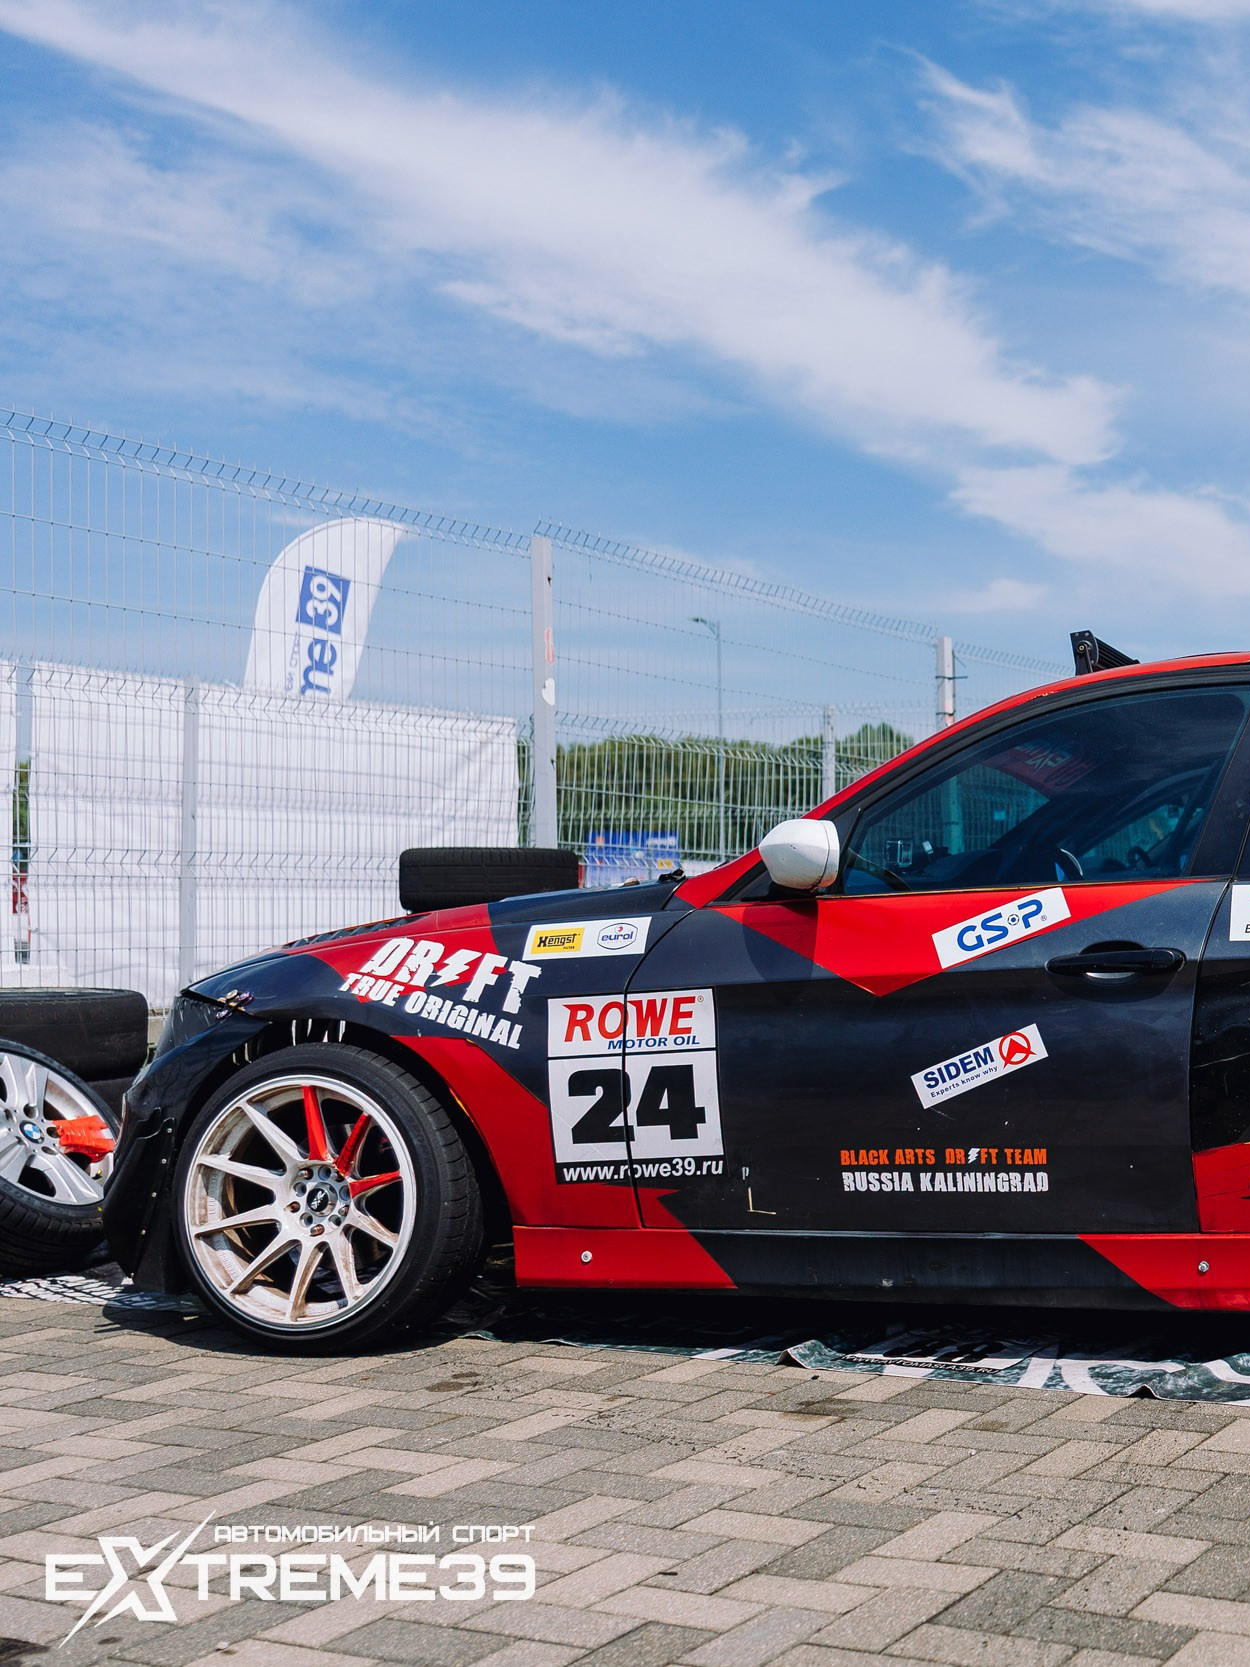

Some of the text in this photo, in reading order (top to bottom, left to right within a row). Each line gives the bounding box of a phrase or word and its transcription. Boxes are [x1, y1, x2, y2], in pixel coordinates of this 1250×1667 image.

[537, 933, 577, 947] Hengst
[601, 931, 634, 942] eurol
[338, 972, 523, 1050] TRUE ORIGINAL
[563, 996, 696, 1042] ROWE
[607, 1035, 700, 1050] MOTOR OIL
[923, 1046, 995, 1090] SIDEM
[930, 1065, 998, 1098] Experts know why
[568, 1064, 706, 1144] 24
[840, 1149, 889, 1165] BLACK
[894, 1149, 936, 1165] ARTS
[1004, 1148, 1047, 1165] TEAM
[563, 1158, 724, 1181] www.rowe39.ru
[842, 1171, 1049, 1192] RUSSIA KALININGRAD
